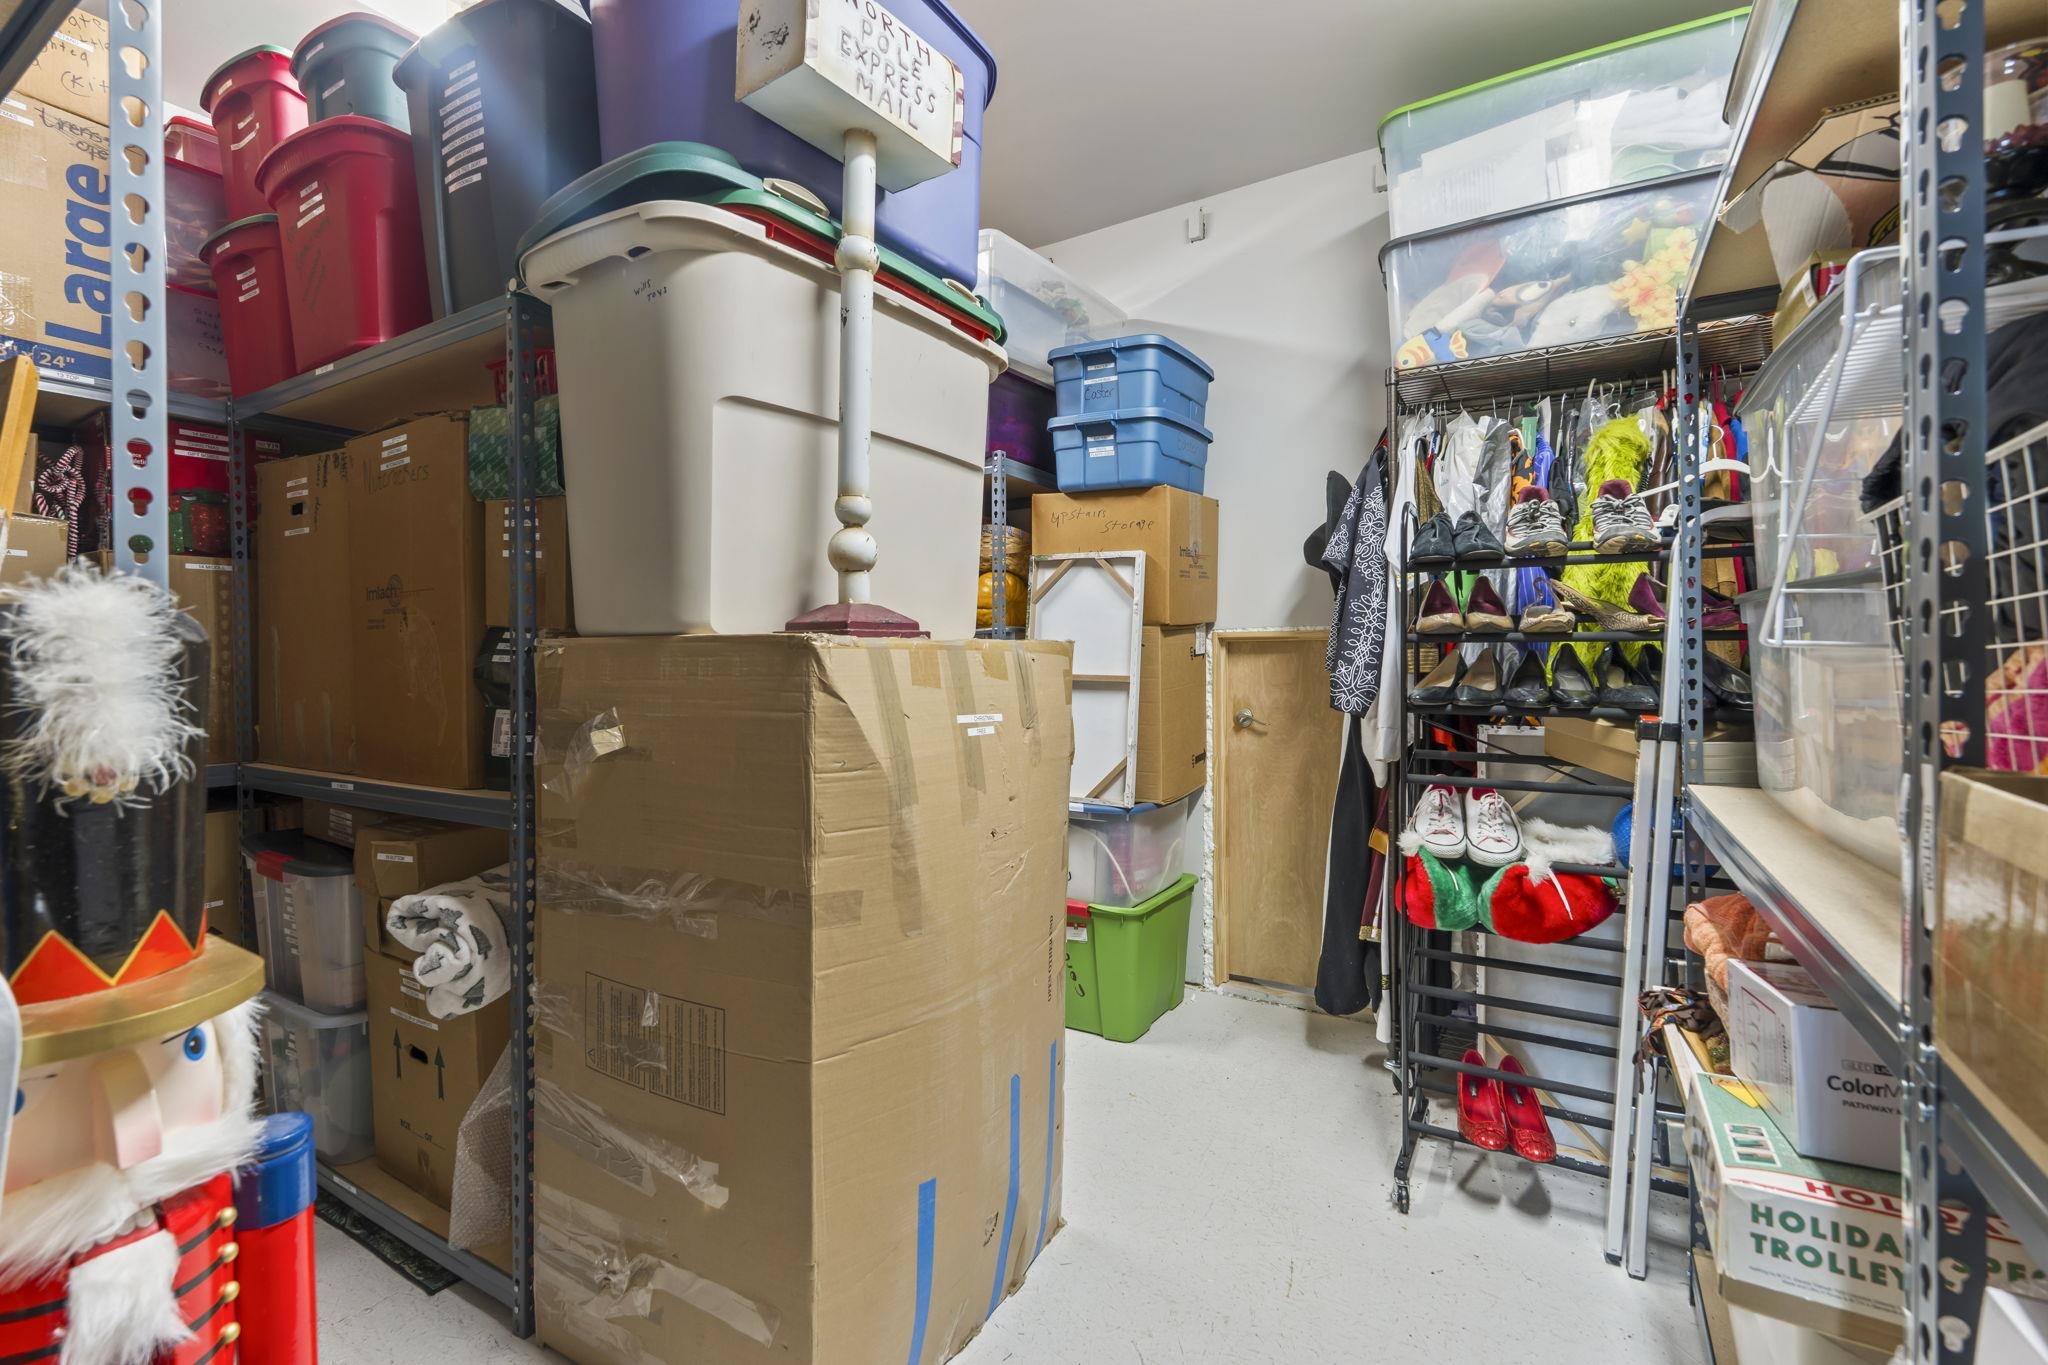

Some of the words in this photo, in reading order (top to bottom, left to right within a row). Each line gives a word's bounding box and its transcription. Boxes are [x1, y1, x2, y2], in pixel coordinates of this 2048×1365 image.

[841, 28, 936, 113] EXPRESS
[862, 18, 922, 80] POLE
[857, 73, 918, 130] MAIL
[45, 163, 112, 348] Large
[40, 352, 75, 368] 24"
[1085, 384, 1114, 400] Easter
[1842, 1099, 1894, 1114] PATHWAY
[1750, 1202, 1904, 1259] HOLIDA
